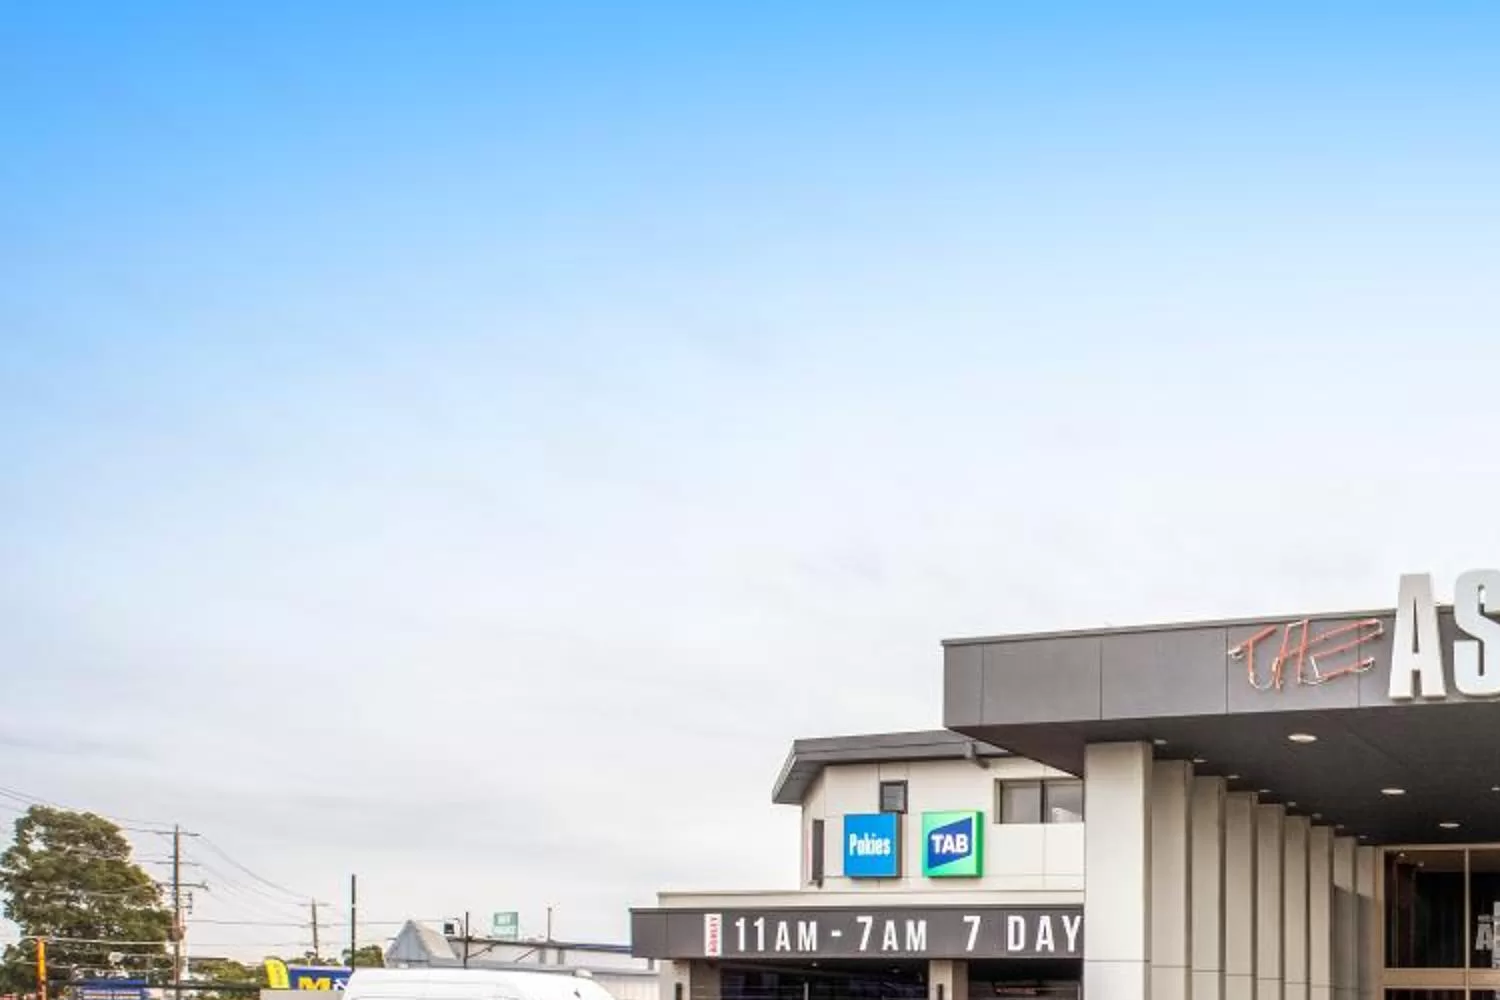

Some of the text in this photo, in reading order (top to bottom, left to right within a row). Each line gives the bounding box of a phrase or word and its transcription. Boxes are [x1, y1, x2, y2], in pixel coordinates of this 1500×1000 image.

[1228, 618, 1383, 690] THE
[931, 832, 970, 855] TAB
[735, 916, 818, 952] 11AM
[856, 914, 928, 952] 7AM
[963, 914, 982, 952] 7
